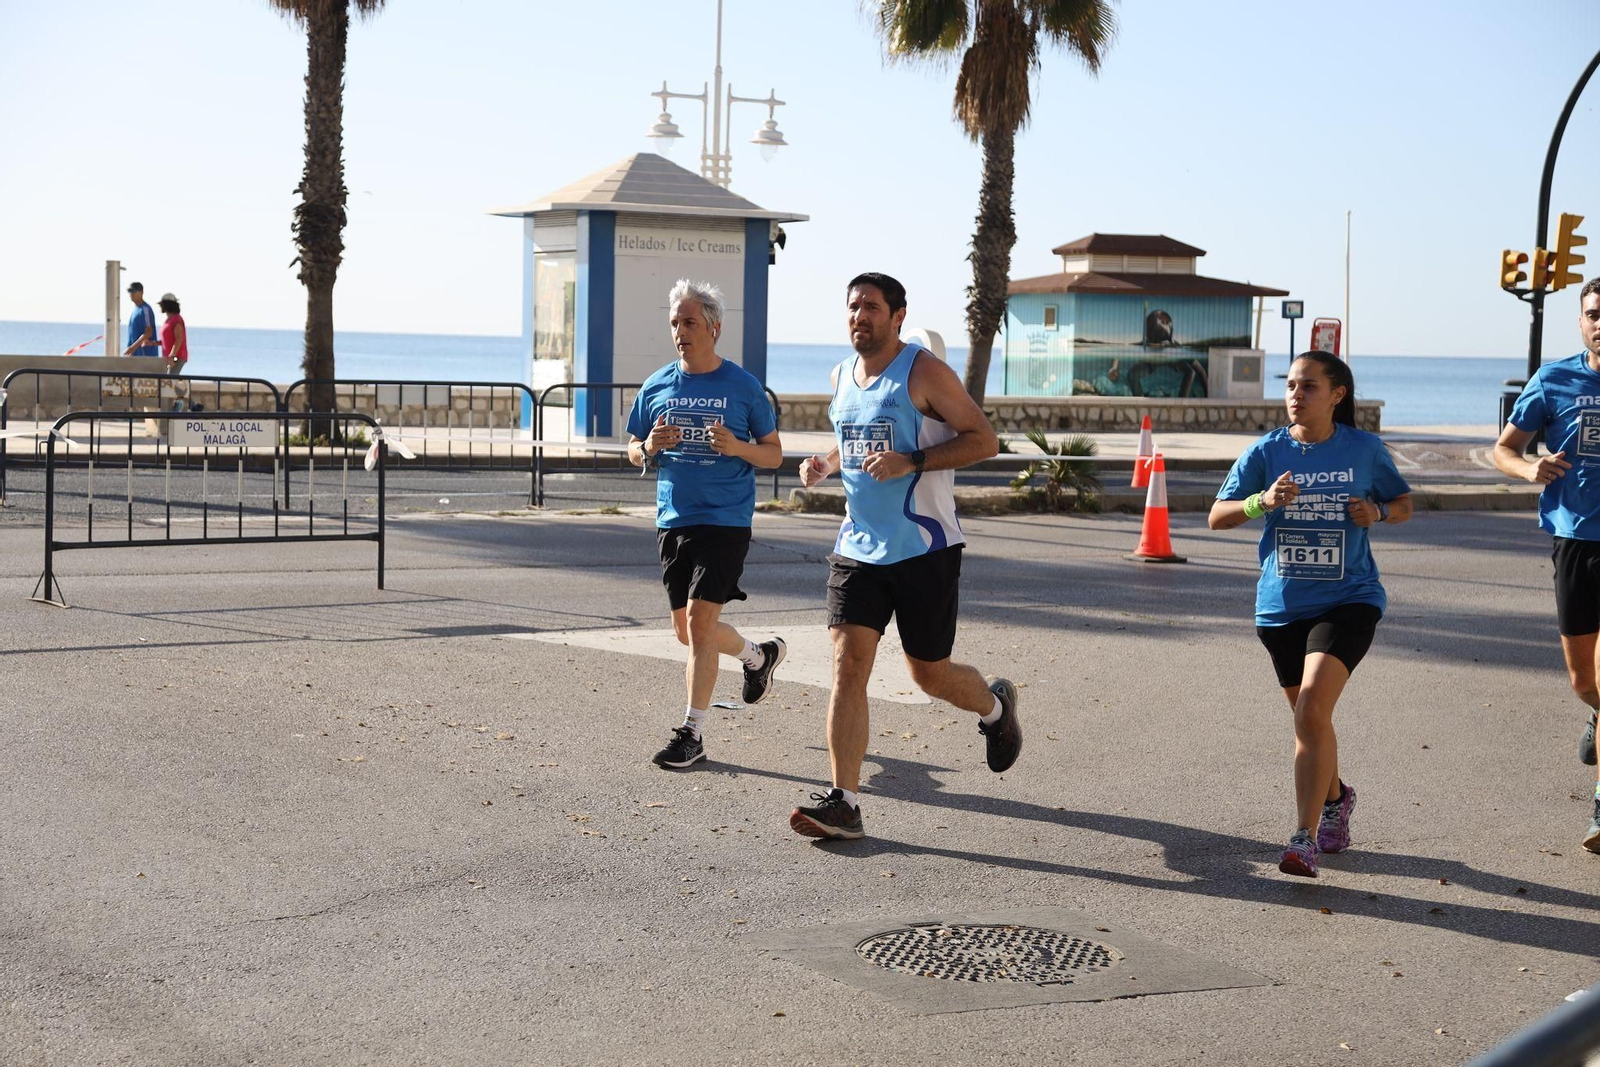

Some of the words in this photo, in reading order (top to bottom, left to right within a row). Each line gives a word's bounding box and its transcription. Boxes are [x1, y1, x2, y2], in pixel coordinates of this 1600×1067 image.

[619, 235, 666, 250] Helados
[677, 237, 695, 252] Ice
[698, 239, 741, 254] Creams
[666, 397, 727, 409] mayoral
[186, 422, 226, 432] POLA
[230, 422, 263, 432] LOCAL
[203, 434, 247, 445] MALAGA
[847, 441, 886, 455] 1914
[1291, 493, 1350, 504] UNNING
[1285, 503, 1344, 512] MAKES
[1284, 512, 1345, 522] FRIENDS
[1283, 547, 1333, 563] 1611
